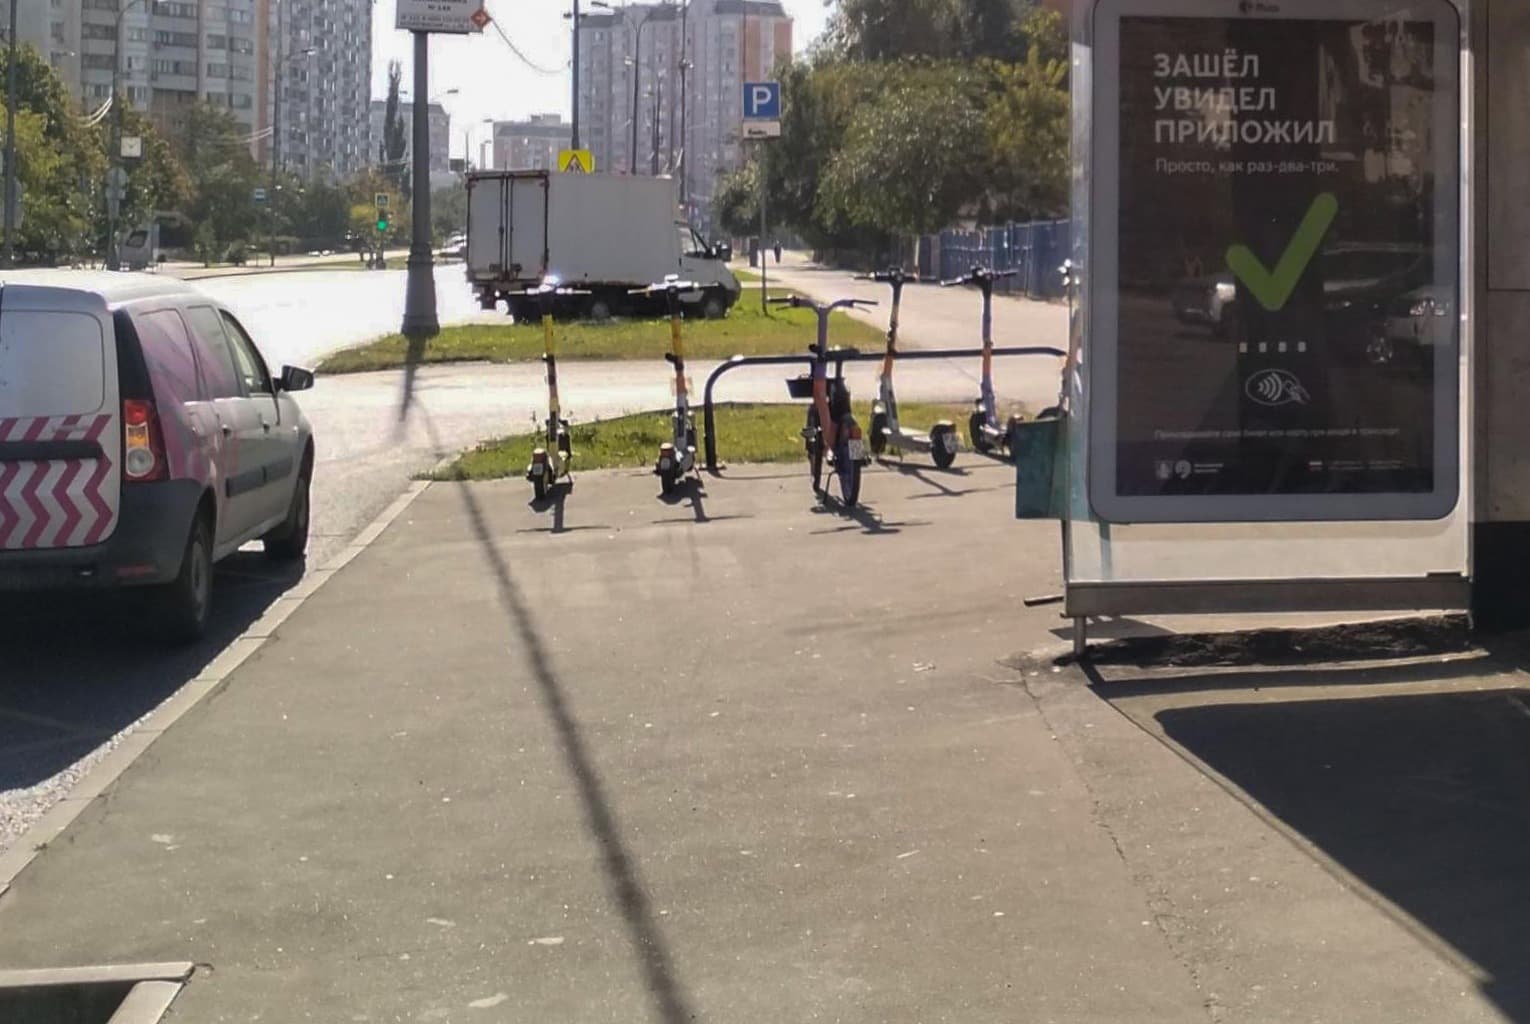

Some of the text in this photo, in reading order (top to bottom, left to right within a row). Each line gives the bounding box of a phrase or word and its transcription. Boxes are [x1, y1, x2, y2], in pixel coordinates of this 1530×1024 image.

[1153, 48, 1260, 78] ЗАШЁЛ
[752, 85, 772, 115] P
[1153, 87, 1277, 114] УВИДЕЛ
[1154, 119, 1336, 144] ПРИЛОЖИЛ
[1155, 157, 1216, 175] Просто,
[1218, 160, 1245, 173] как
